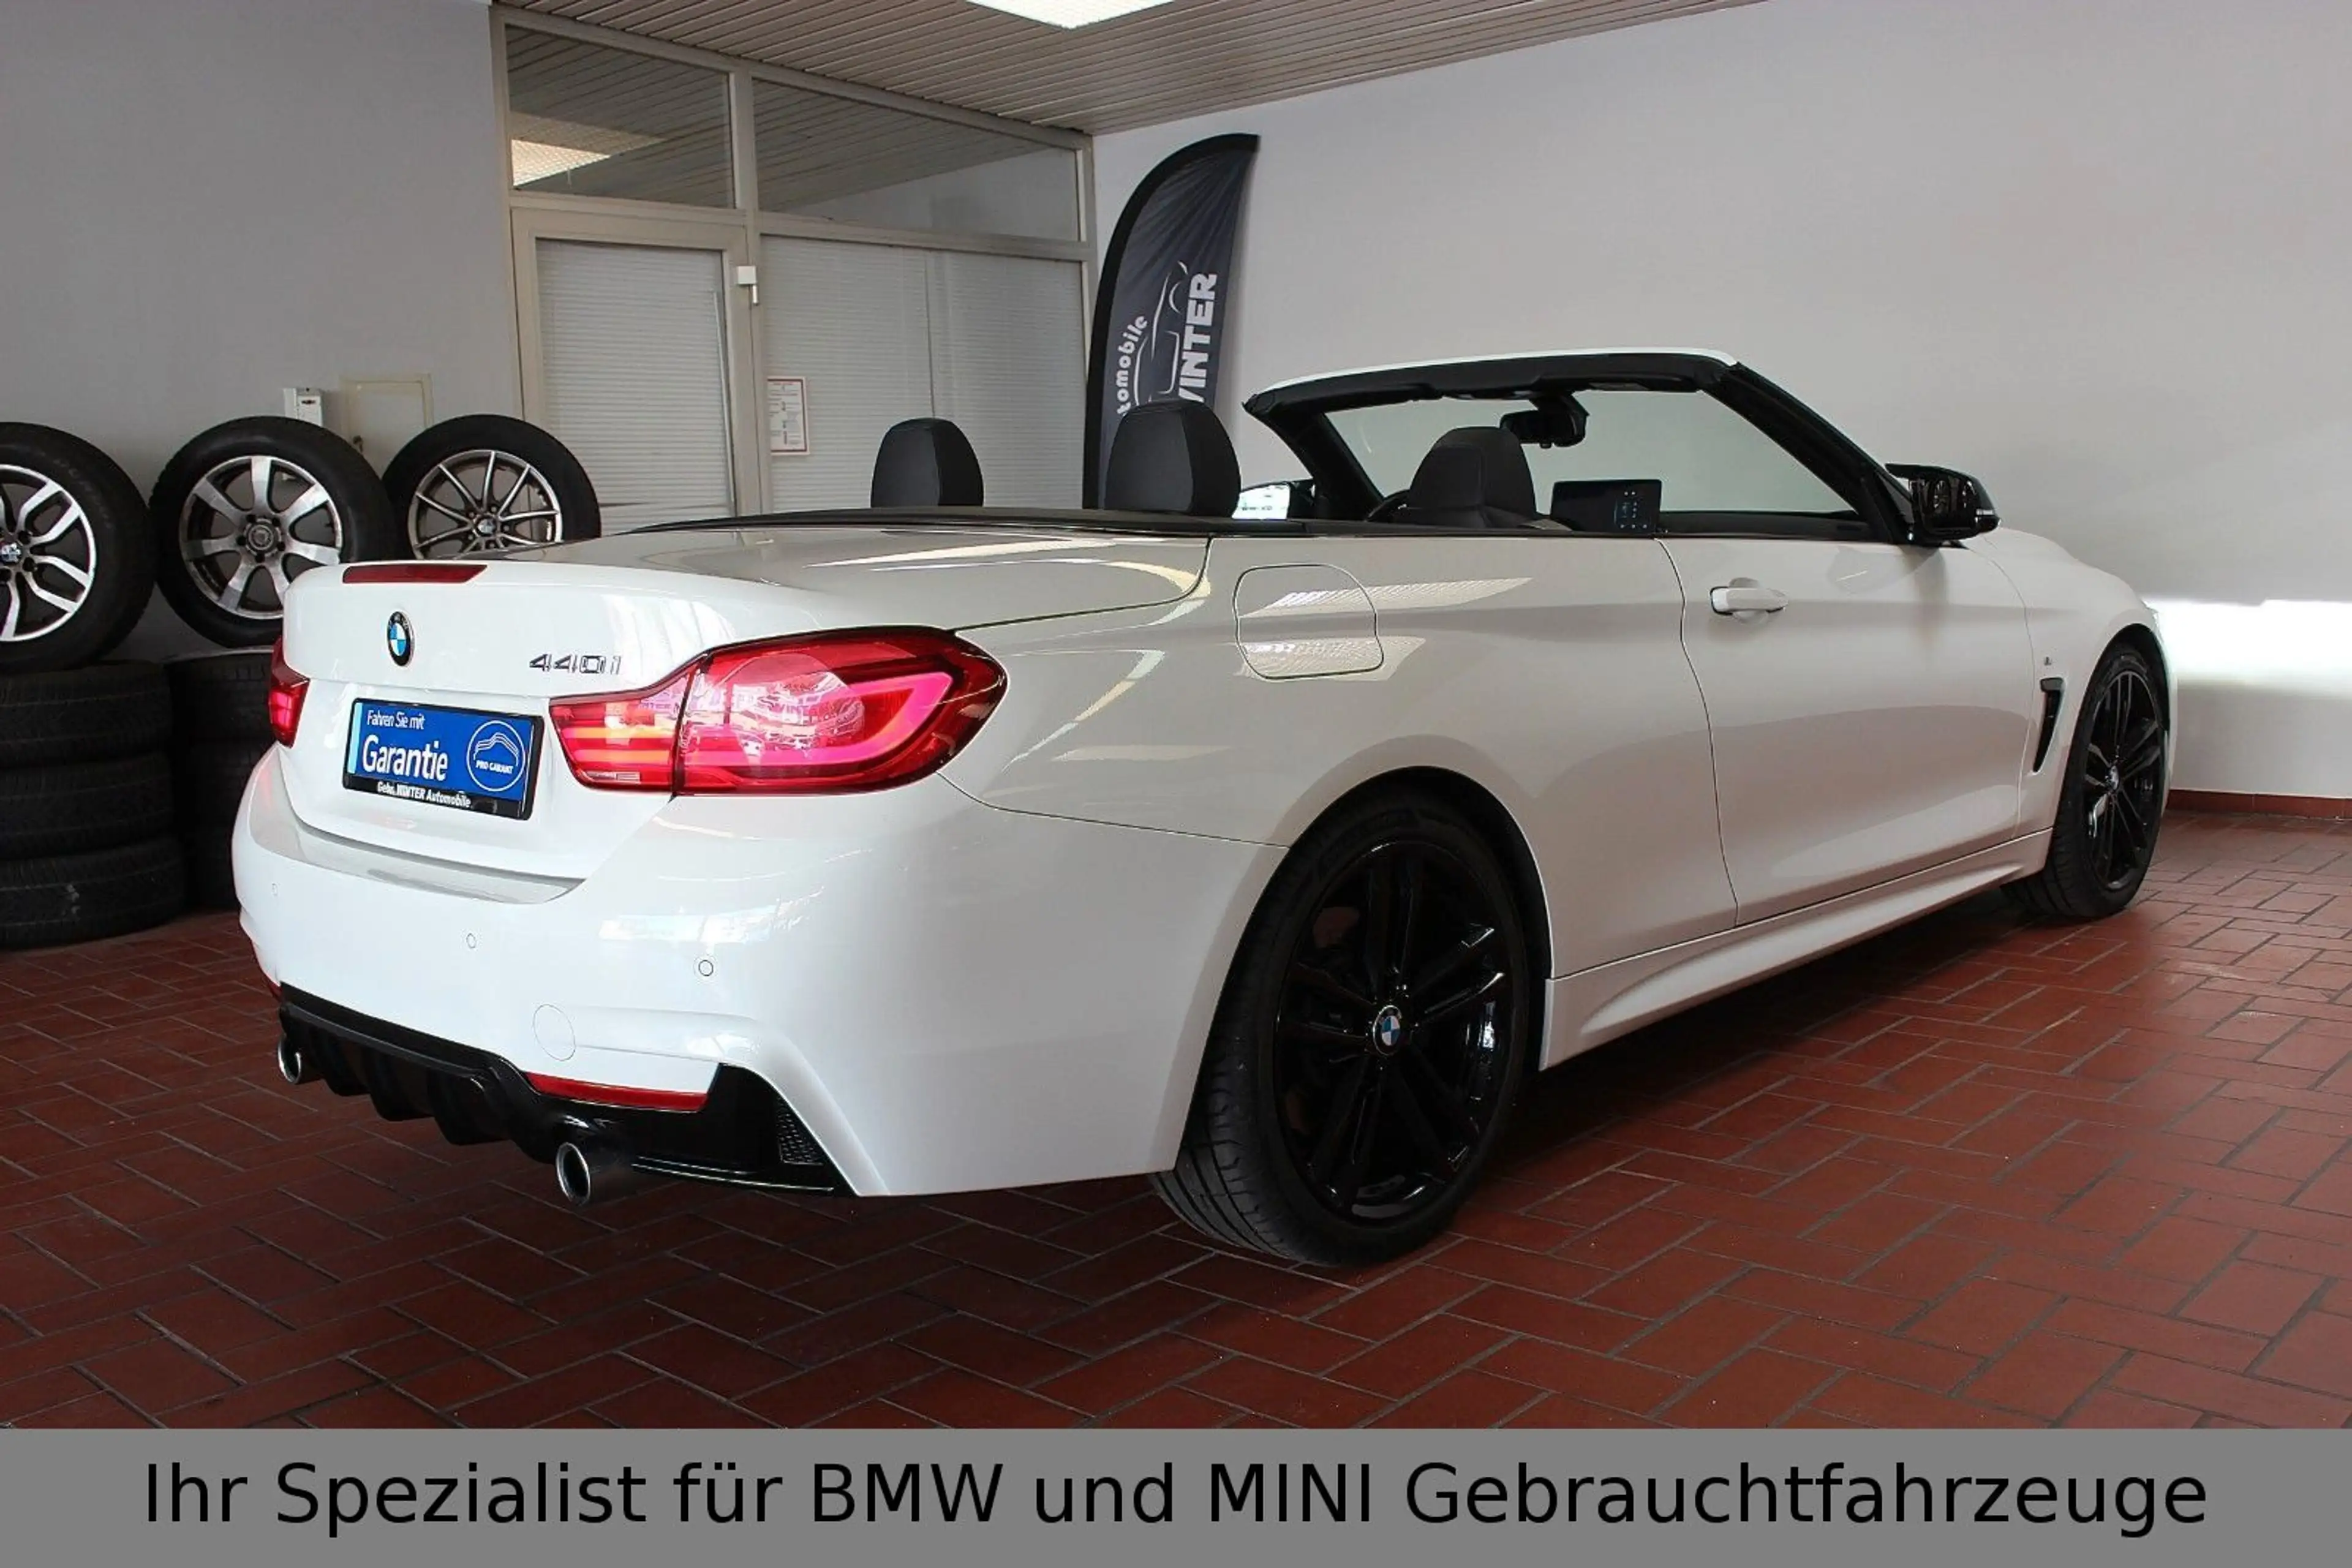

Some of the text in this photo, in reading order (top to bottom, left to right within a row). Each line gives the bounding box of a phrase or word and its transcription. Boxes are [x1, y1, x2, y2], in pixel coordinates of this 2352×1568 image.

[1178, 273, 1218, 403] INTER
[529, 654, 621, 675] 440i
[367, 709, 426, 730] Fahren Sie mit
[363, 734, 448, 782] Garantie
